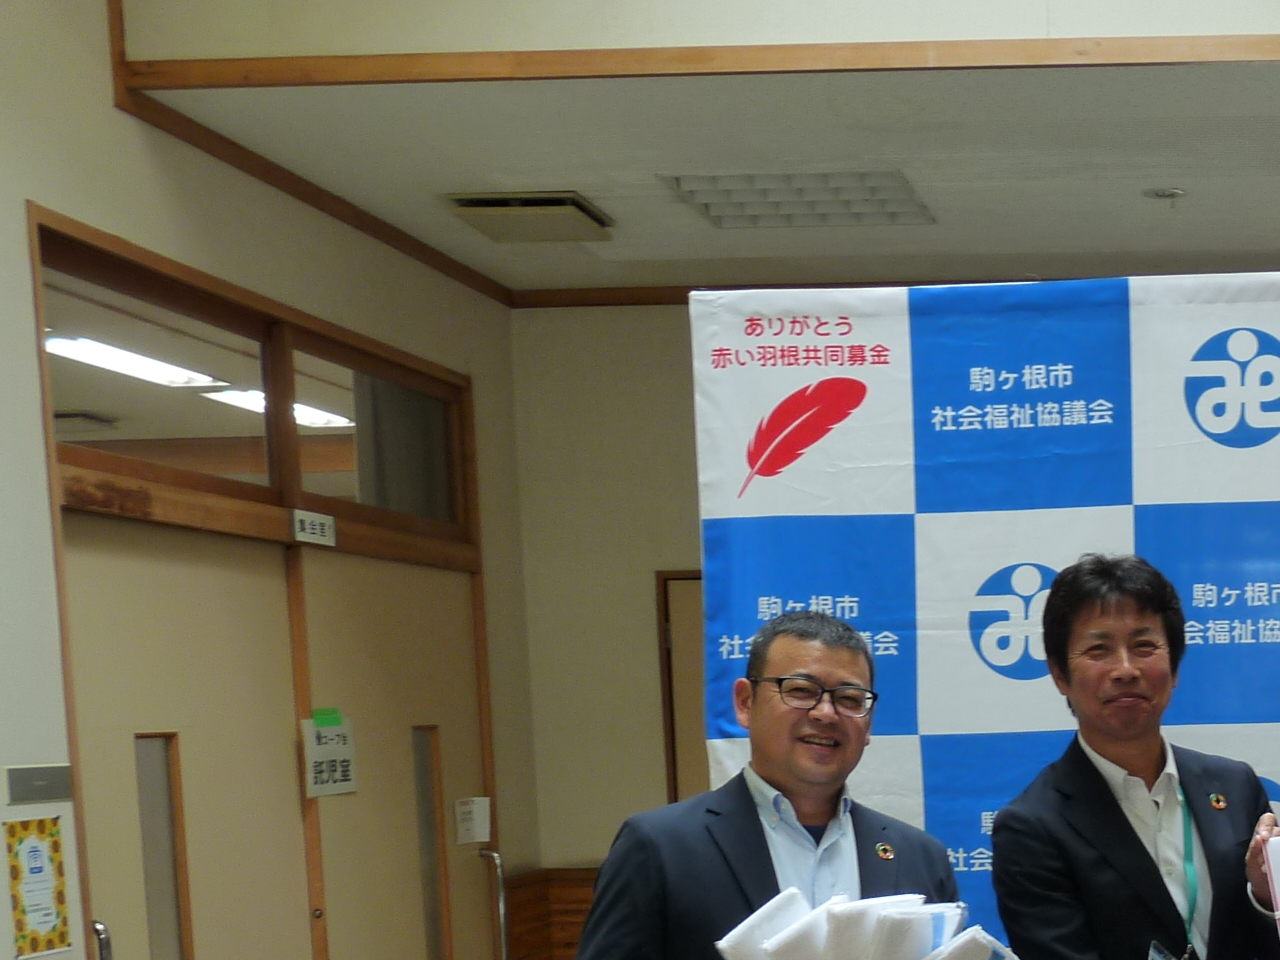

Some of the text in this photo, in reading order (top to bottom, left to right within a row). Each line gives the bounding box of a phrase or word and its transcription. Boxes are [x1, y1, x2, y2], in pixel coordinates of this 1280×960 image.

[745, 316, 852, 337] ありがとう
[711, 344, 889, 368] 赤い羽根共同募金
[969, 364, 1073, 391] 駒ヶ根市
[931, 399, 1114, 431] 社会福祉協議会
